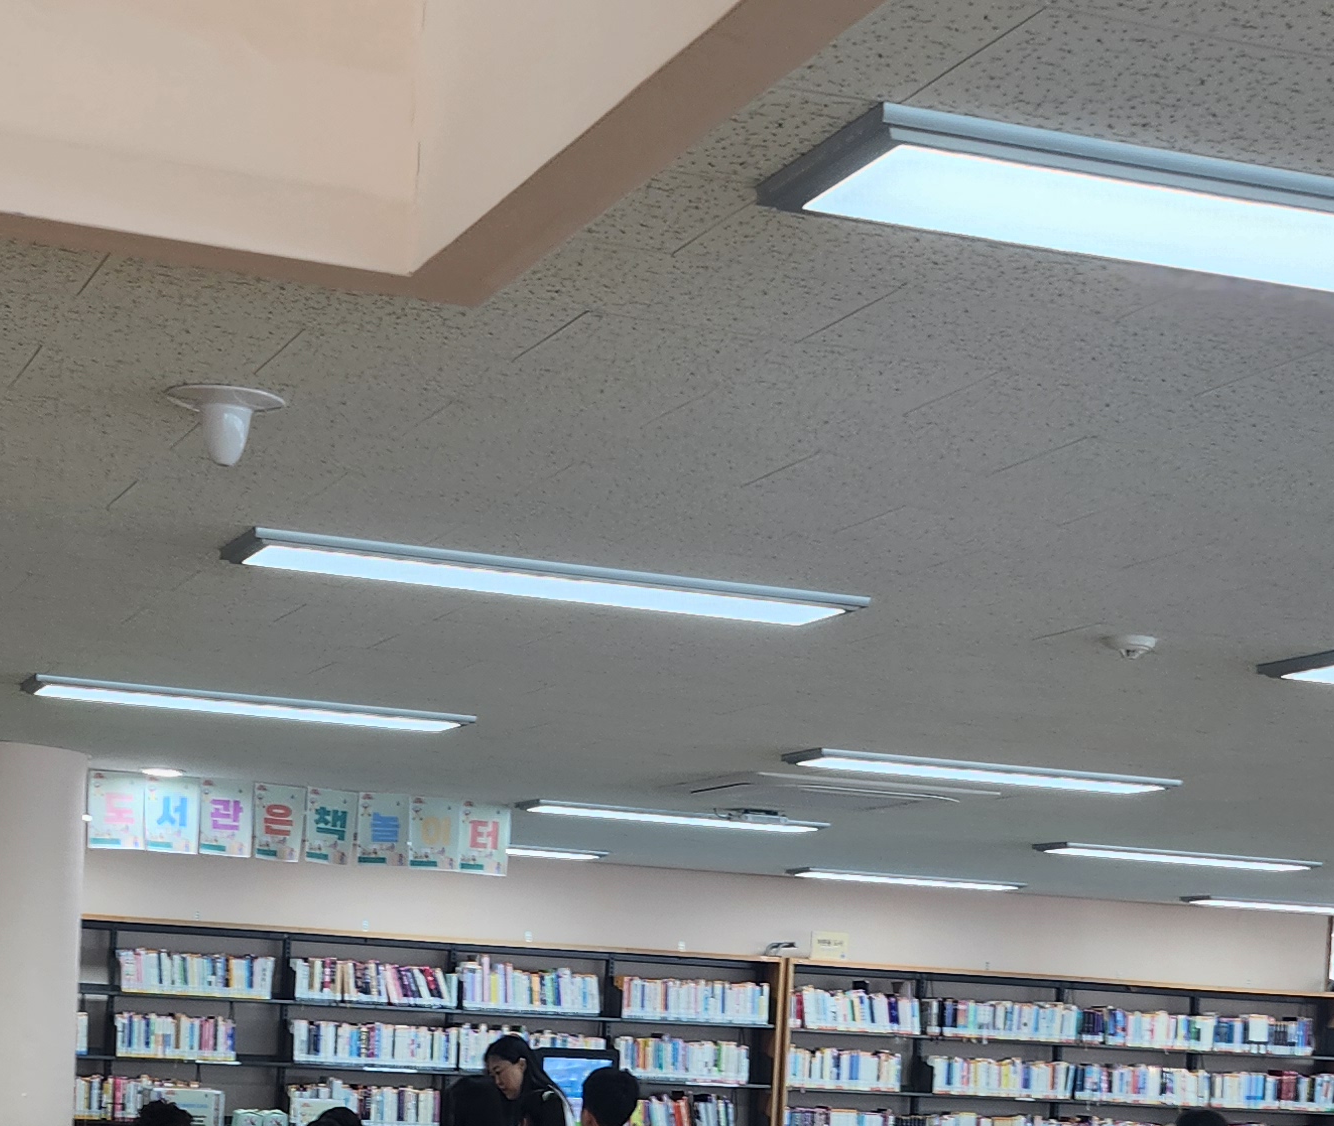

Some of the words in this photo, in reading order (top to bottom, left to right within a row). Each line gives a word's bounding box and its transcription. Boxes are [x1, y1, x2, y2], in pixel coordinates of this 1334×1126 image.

[103, 791, 294, 837] 도서관은
[314, 805, 349, 842] 책
[370, 811, 500, 852] 놀이터
